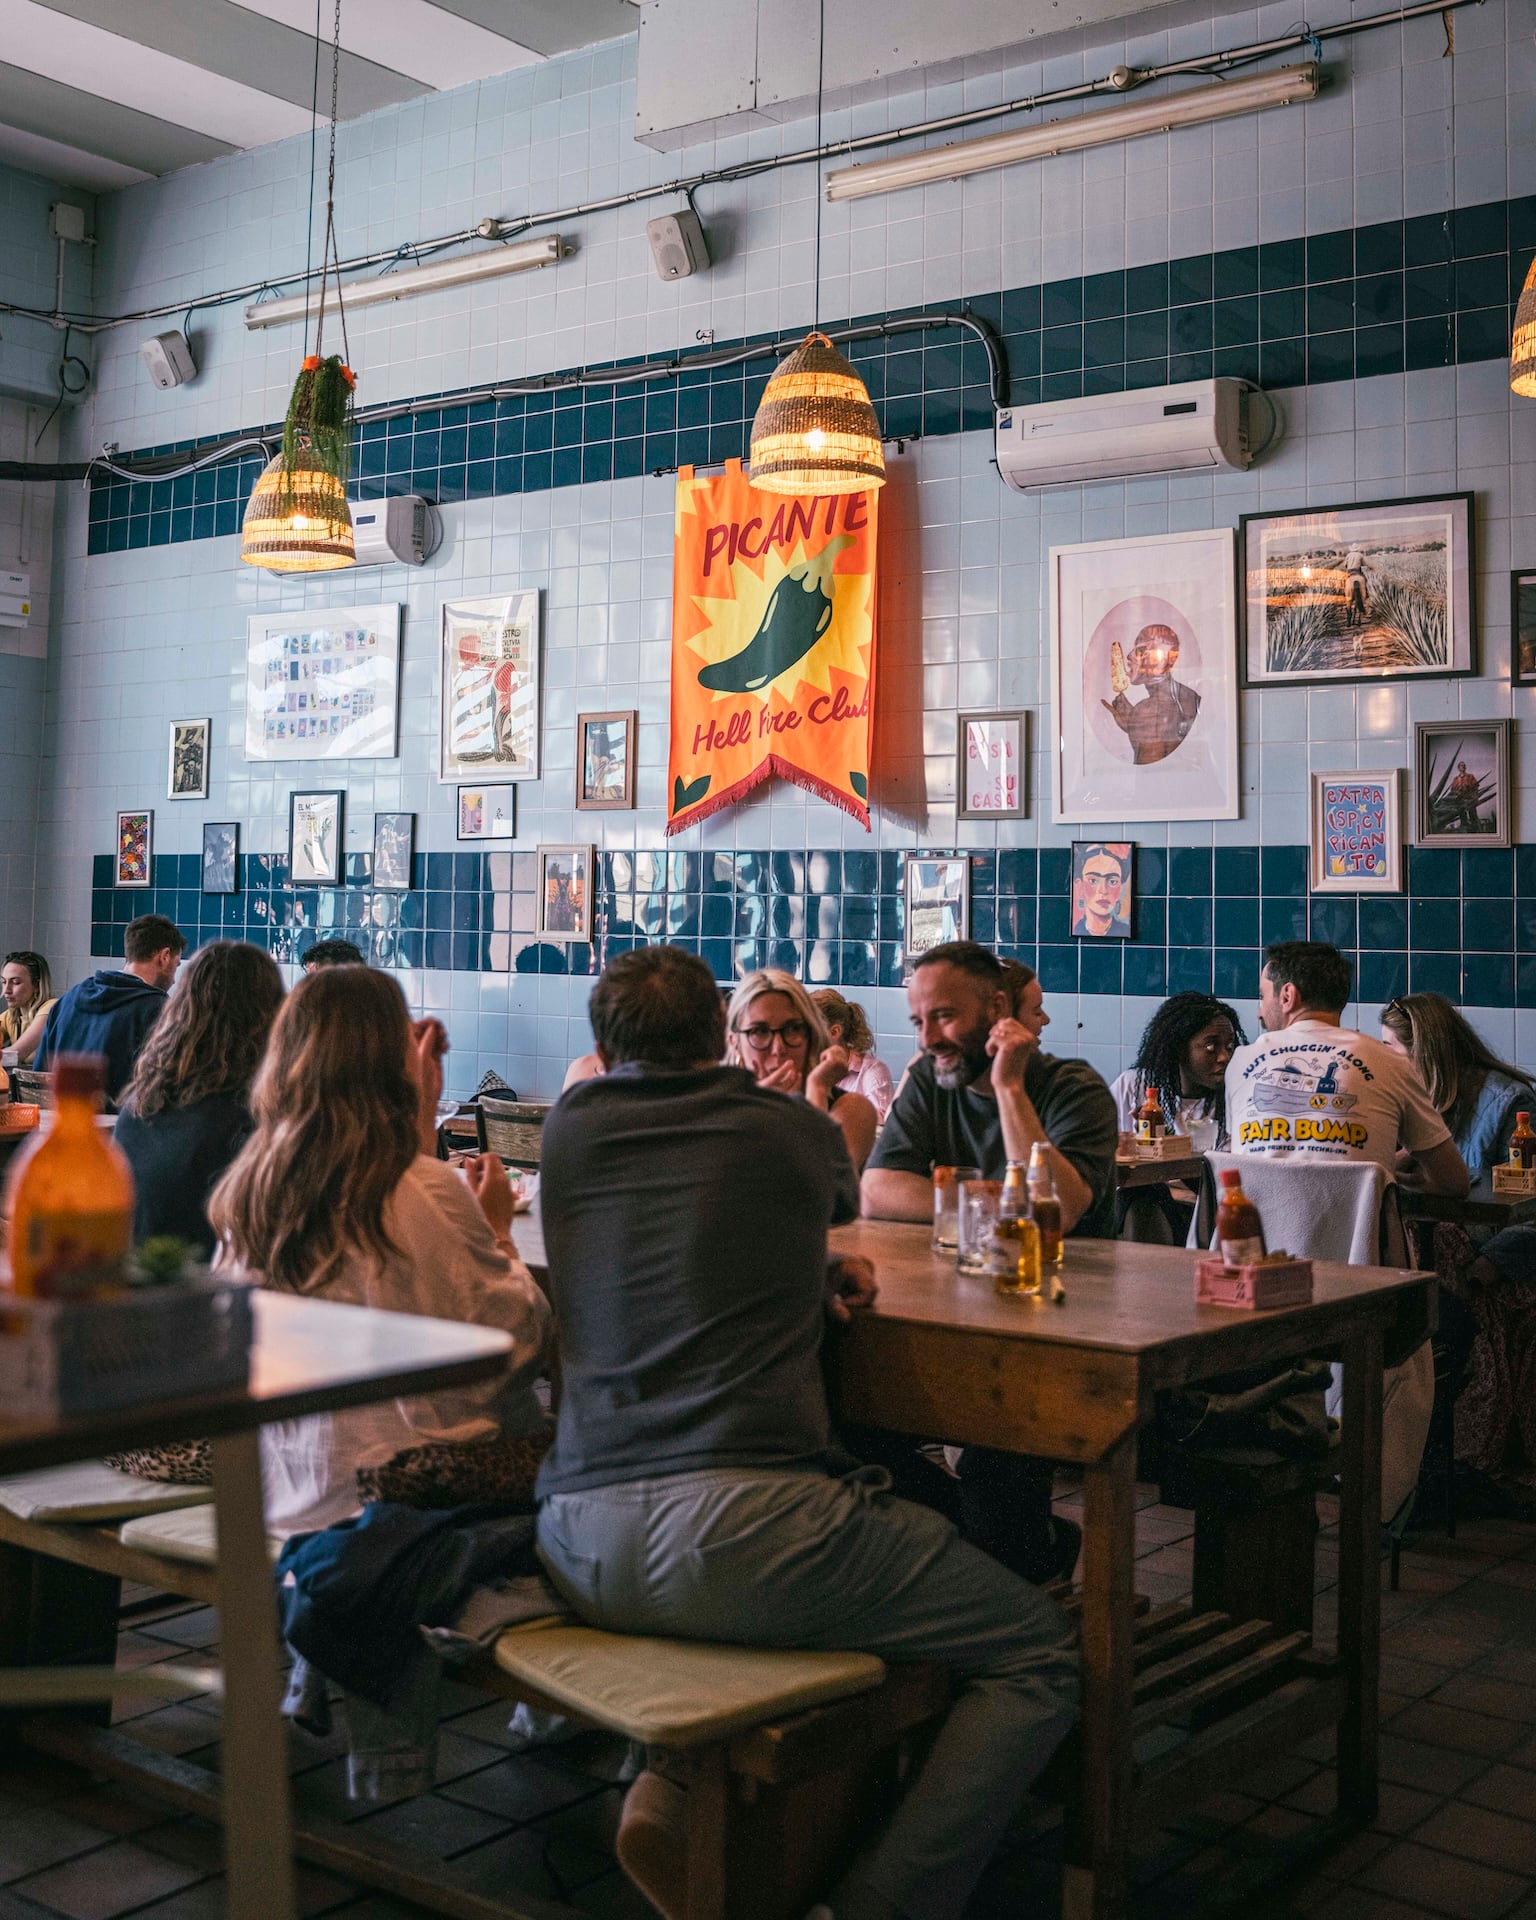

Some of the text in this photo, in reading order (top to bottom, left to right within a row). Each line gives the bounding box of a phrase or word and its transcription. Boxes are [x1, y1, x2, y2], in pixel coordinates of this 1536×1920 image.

[703, 491, 867, 576] PICANTE
[692, 682, 869, 755] Hell Fire Club
[995, 774, 1016, 791] SU
[972, 793, 1015, 808] CASA
[1243, 1053, 1266, 1079] JUST
[1337, 1050, 1374, 1081] ALONG
